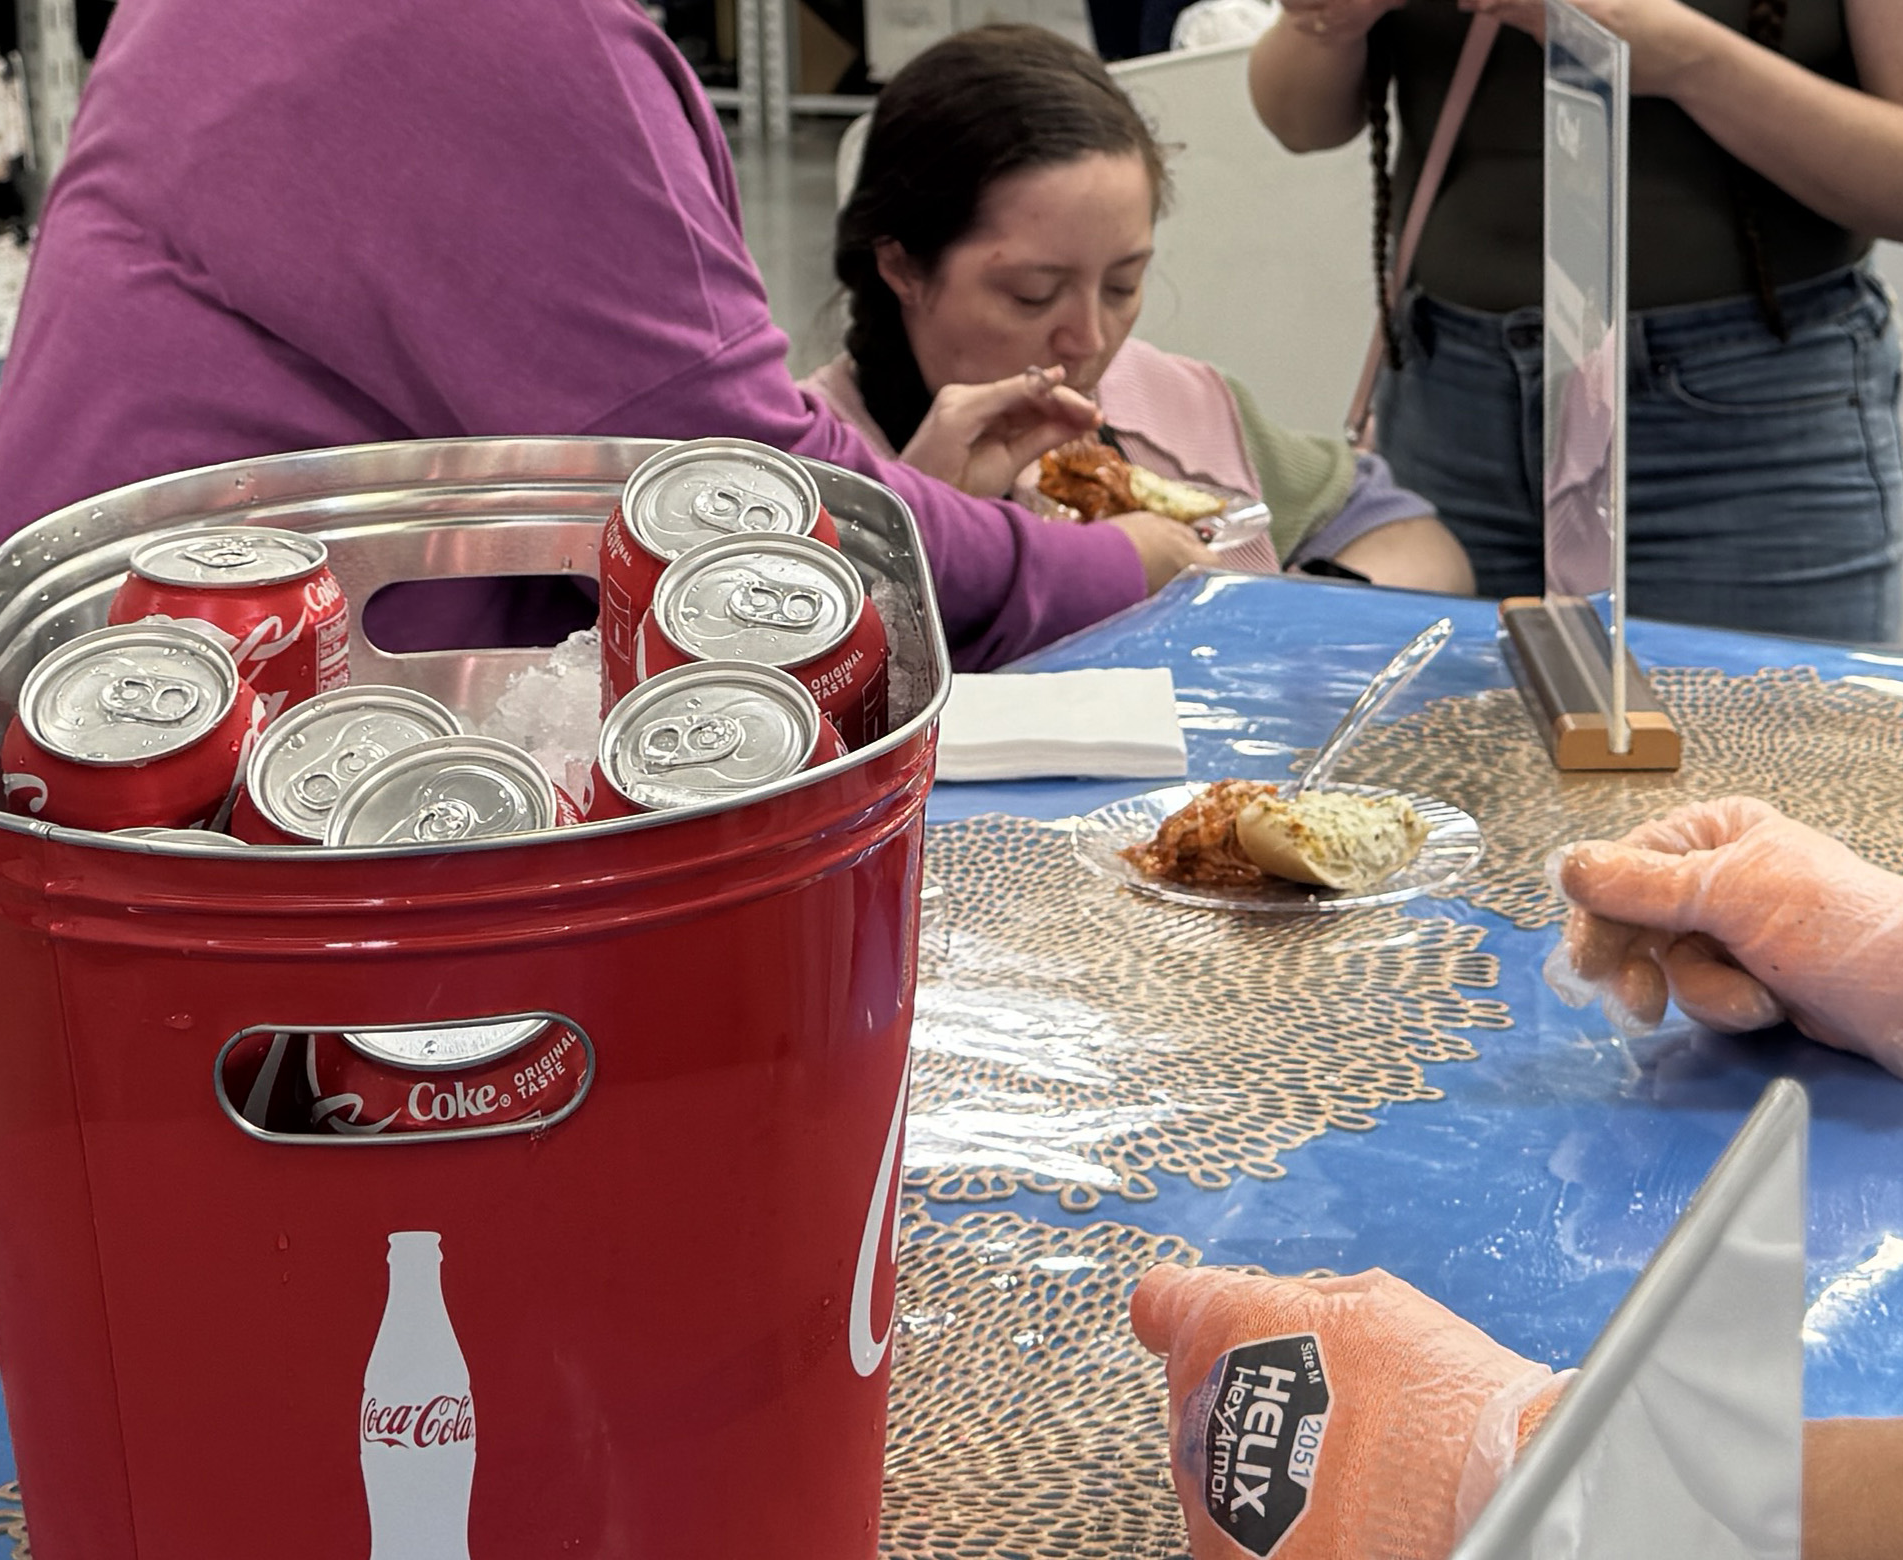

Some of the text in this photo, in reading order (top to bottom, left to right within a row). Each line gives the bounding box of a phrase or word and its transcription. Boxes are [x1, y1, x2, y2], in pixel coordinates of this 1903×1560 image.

[811, 648, 864, 690] ORIGINAL
[813, 674, 853, 702] TASTE
[408, 1031, 577, 1122] Coke ORIGINAL
[517, 1060, 566, 1099] TASTE
[1301, 1342, 1321, 1384] Size M
[363, 1395, 475, 1449] Coca-Cola
[1211, 1366, 1257, 1505] HexArmor
[1230, 1365, 1296, 1518] HELIX
[1291, 1417, 1322, 1483] 2051
